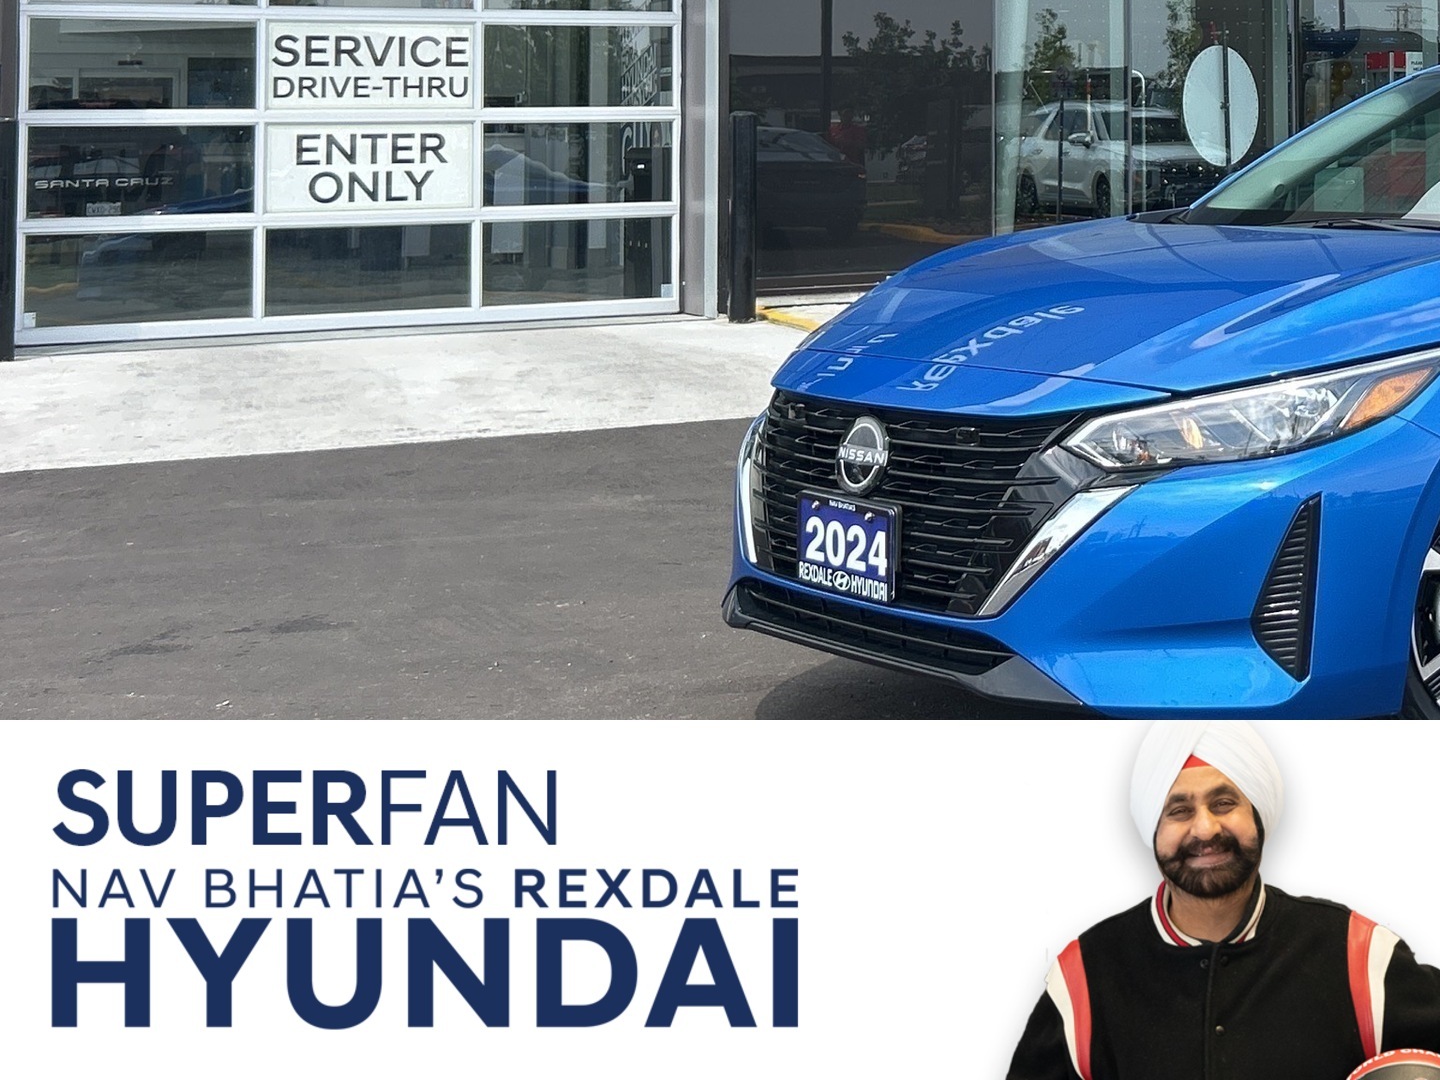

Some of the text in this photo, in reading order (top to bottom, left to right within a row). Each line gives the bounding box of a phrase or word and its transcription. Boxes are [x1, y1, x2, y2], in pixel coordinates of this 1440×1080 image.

[272, 34, 469, 67] SERVICE
[273, 76, 469, 98] DRIVE-THRU
[296, 133, 448, 165] ENTER
[34, 177, 174, 189] SANTA CRUZ
[309, 170, 434, 203] ONLY
[839, 447, 886, 465] NISSAN
[805, 516, 887, 576] 2024
[799, 560, 888, 602] REXDALE HYUNDAI
